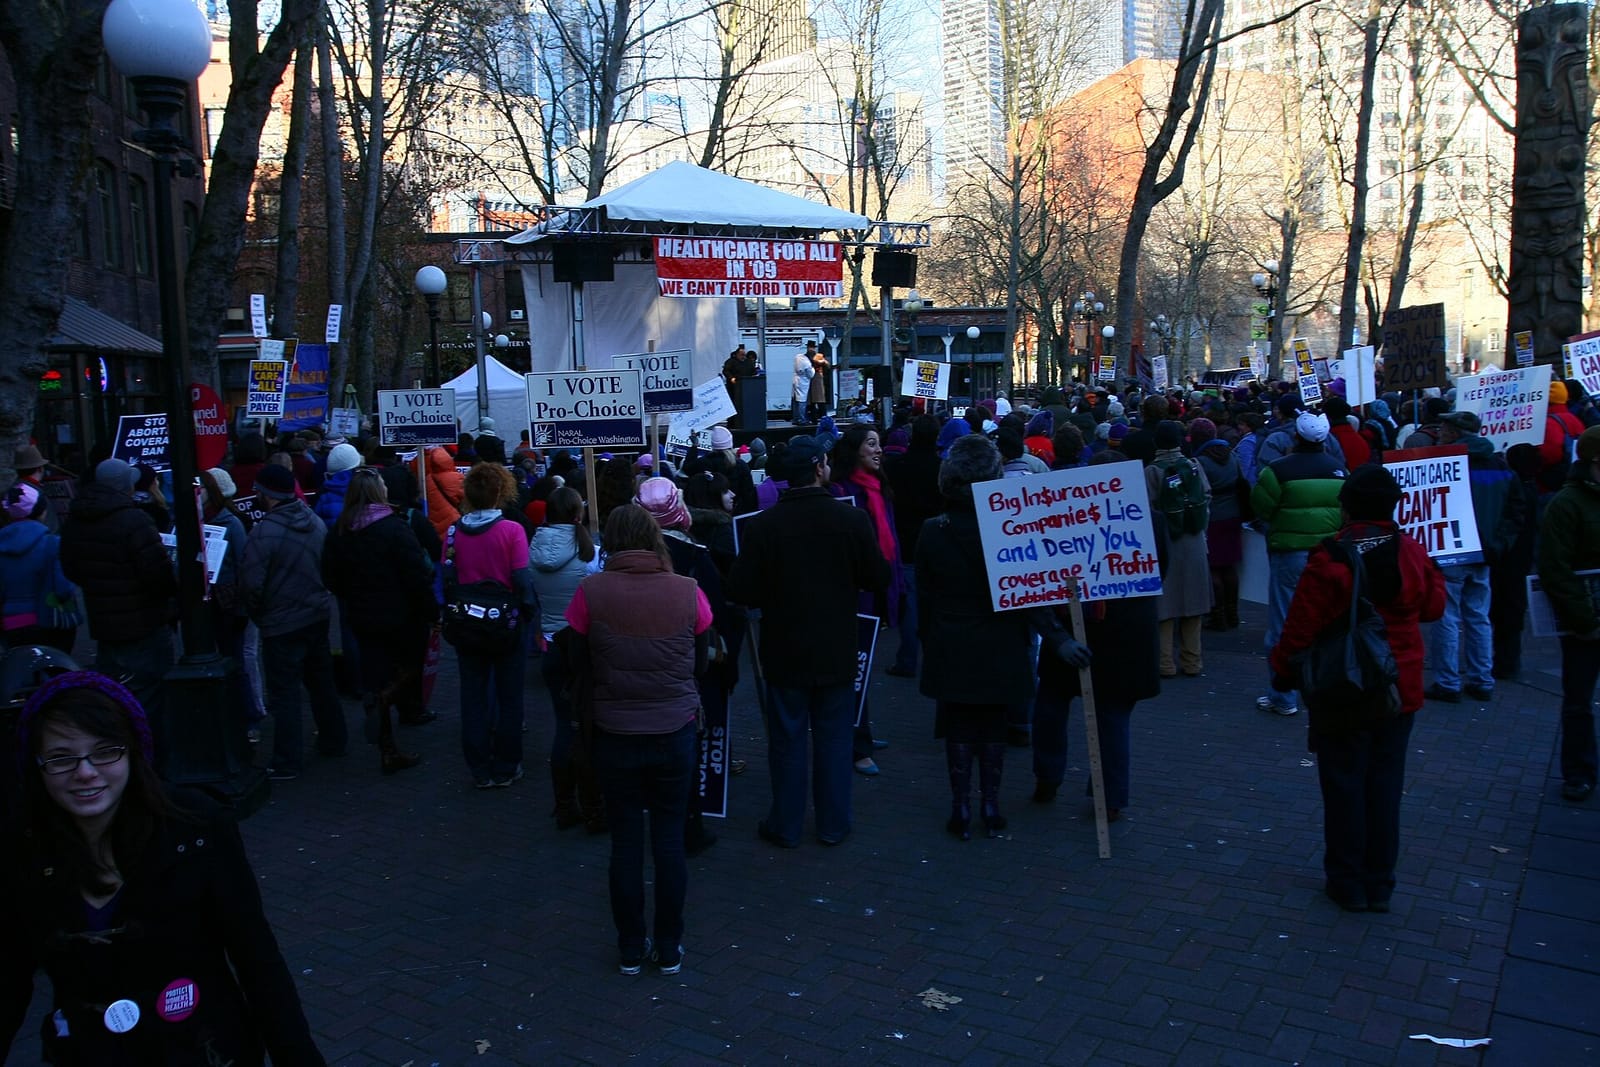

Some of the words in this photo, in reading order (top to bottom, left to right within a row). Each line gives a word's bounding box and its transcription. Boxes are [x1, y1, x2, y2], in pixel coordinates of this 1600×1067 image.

[658, 238, 770, 260] HEALTHCARE
[773, 242, 806, 260] FOR
[810, 244, 837, 262] ALL
[726, 260, 745, 278] IN
[662, 281, 682, 296] WE
[686, 281, 727, 296] CAN'T
[729, 281, 780, 296] AFFORD
[783, 282, 800, 296] TO
[803, 282, 837, 296] WAIT
[1384, 331, 1408, 347] FOR
[1414, 322, 1443, 342] ALL
[1399, 342, 1433, 360] NOW
[252, 362, 283, 371] HEALTH
[640, 356, 680, 372] VOTE
[1389, 360, 1438, 384] 2009
[258, 381, 276, 391] ALL
[546, 379, 555, 396] I
[564, 376, 623, 395] VOTE
[643, 374, 689, 390] -Choice
[249, 393, 281, 402] SINGLE
[393, 395, 400, 408] I
[405, 393, 443, 407] VOTE
[1464, 387, 1490, 401] KEEP
[1492, 384, 1519, 397] YOUR
[1490, 391, 1543, 408] ROSARIES
[250, 403, 279, 411] PAYER
[535, 400, 636, 419] Pro-Choice
[1479, 410, 1493, 423] UT
[1495, 409, 1508, 421] OF
[1513, 405, 1534, 418] OUR
[144, 417, 166, 427] STO
[385, 410, 453, 424] Pro-Choice
[128, 427, 168, 437] ABORT
[557, 430, 583, 438] NARAL
[1480, 417, 1533, 436] OVARIES
[125, 436, 170, 447] COVERA
[559, 437, 597, 445] Pro-Choice
[598, 435, 641, 445] Washington
[141, 446, 165, 456] BAN
[1391, 464, 1427, 488] HEALTH
[1429, 461, 1461, 484] CARE
[988, 492, 1021, 516] Big
[1022, 477, 1123, 507] In$urance
[1398, 486, 1450, 526] CAN'T
[1002, 503, 1101, 535] Companie$
[1106, 498, 1143, 521] Lie
[997, 538, 1038, 562] and
[1041, 533, 1095, 564] Deny
[1099, 525, 1142, 552] You
[1089, 562, 1101, 581] 4
[1103, 550, 1159, 576] Profit
[999, 594, 1010, 608] 6
[710, 725, 725, 775] STOP
[165, 985, 188, 998] PROTECT
[165, 1000, 189, 1012] HEALTH
